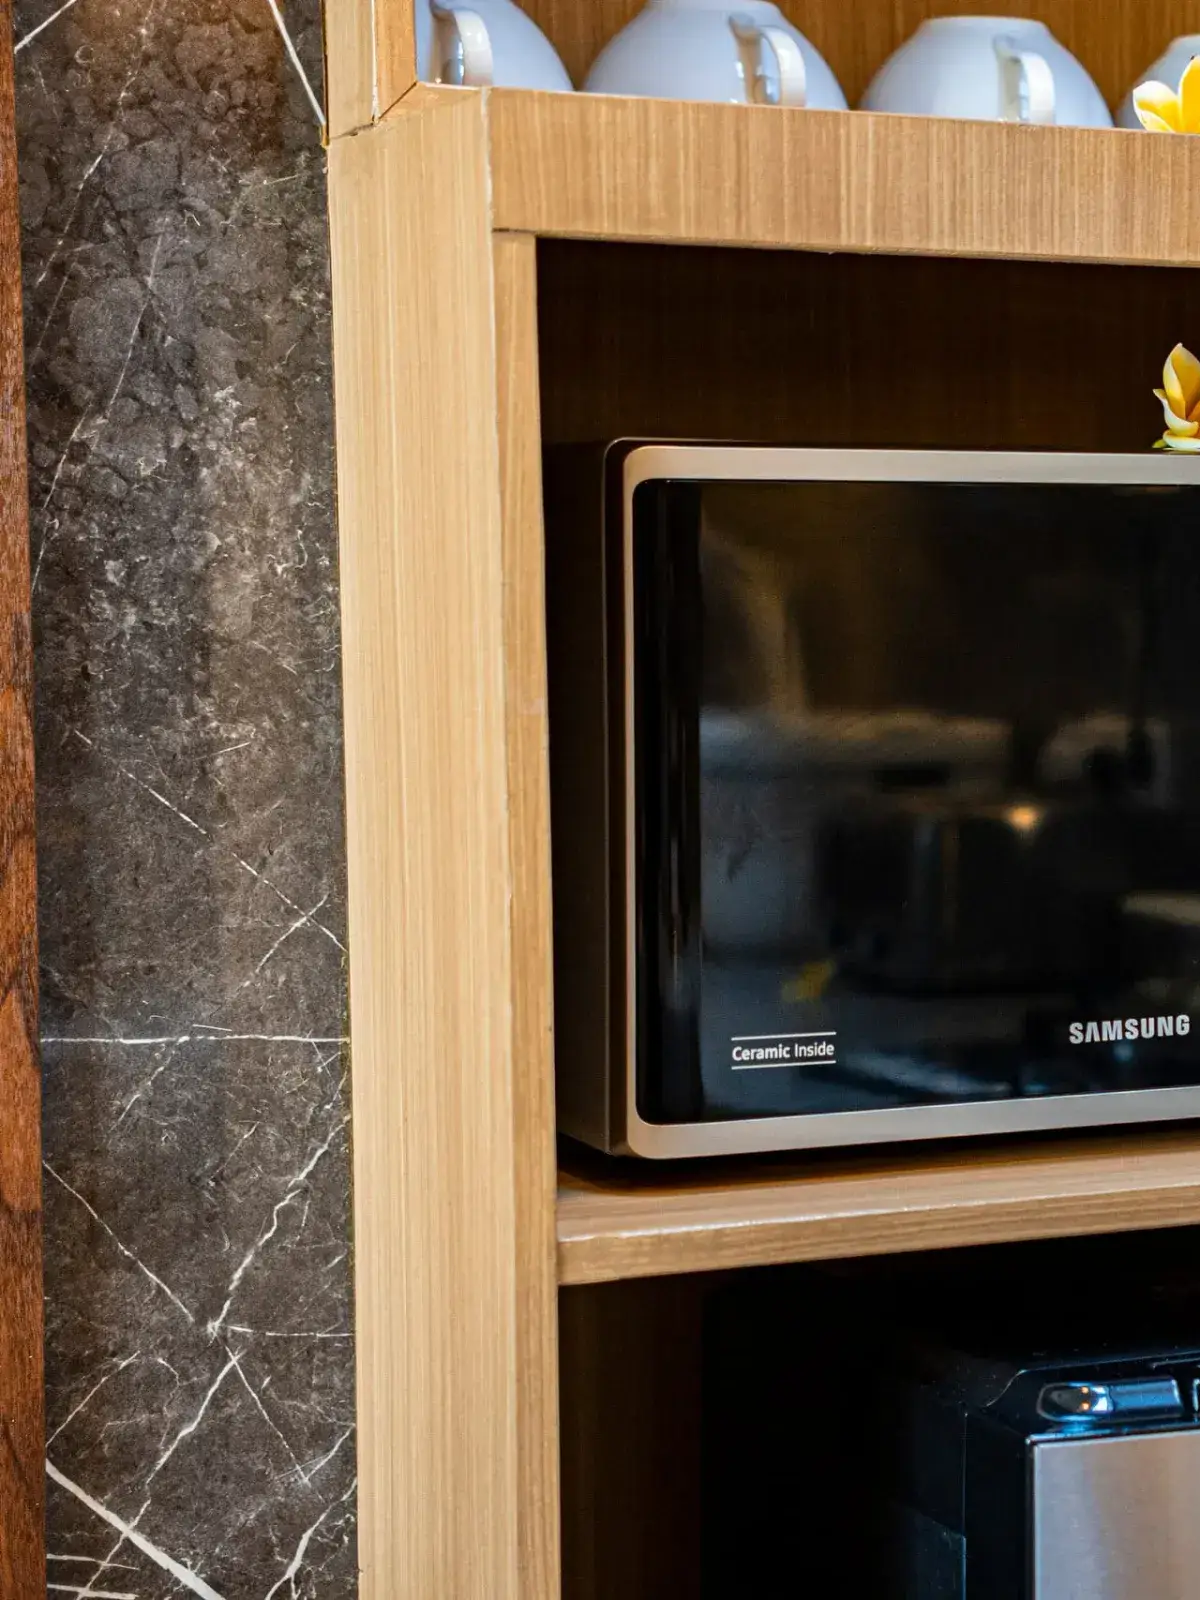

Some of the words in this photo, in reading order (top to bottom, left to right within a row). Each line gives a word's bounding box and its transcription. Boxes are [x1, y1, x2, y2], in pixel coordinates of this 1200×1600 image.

[1069, 1014, 1190, 1044] SAMSUNG
[732, 1043, 791, 1061] Ceramic
[794, 1041, 835, 1058] Inside
